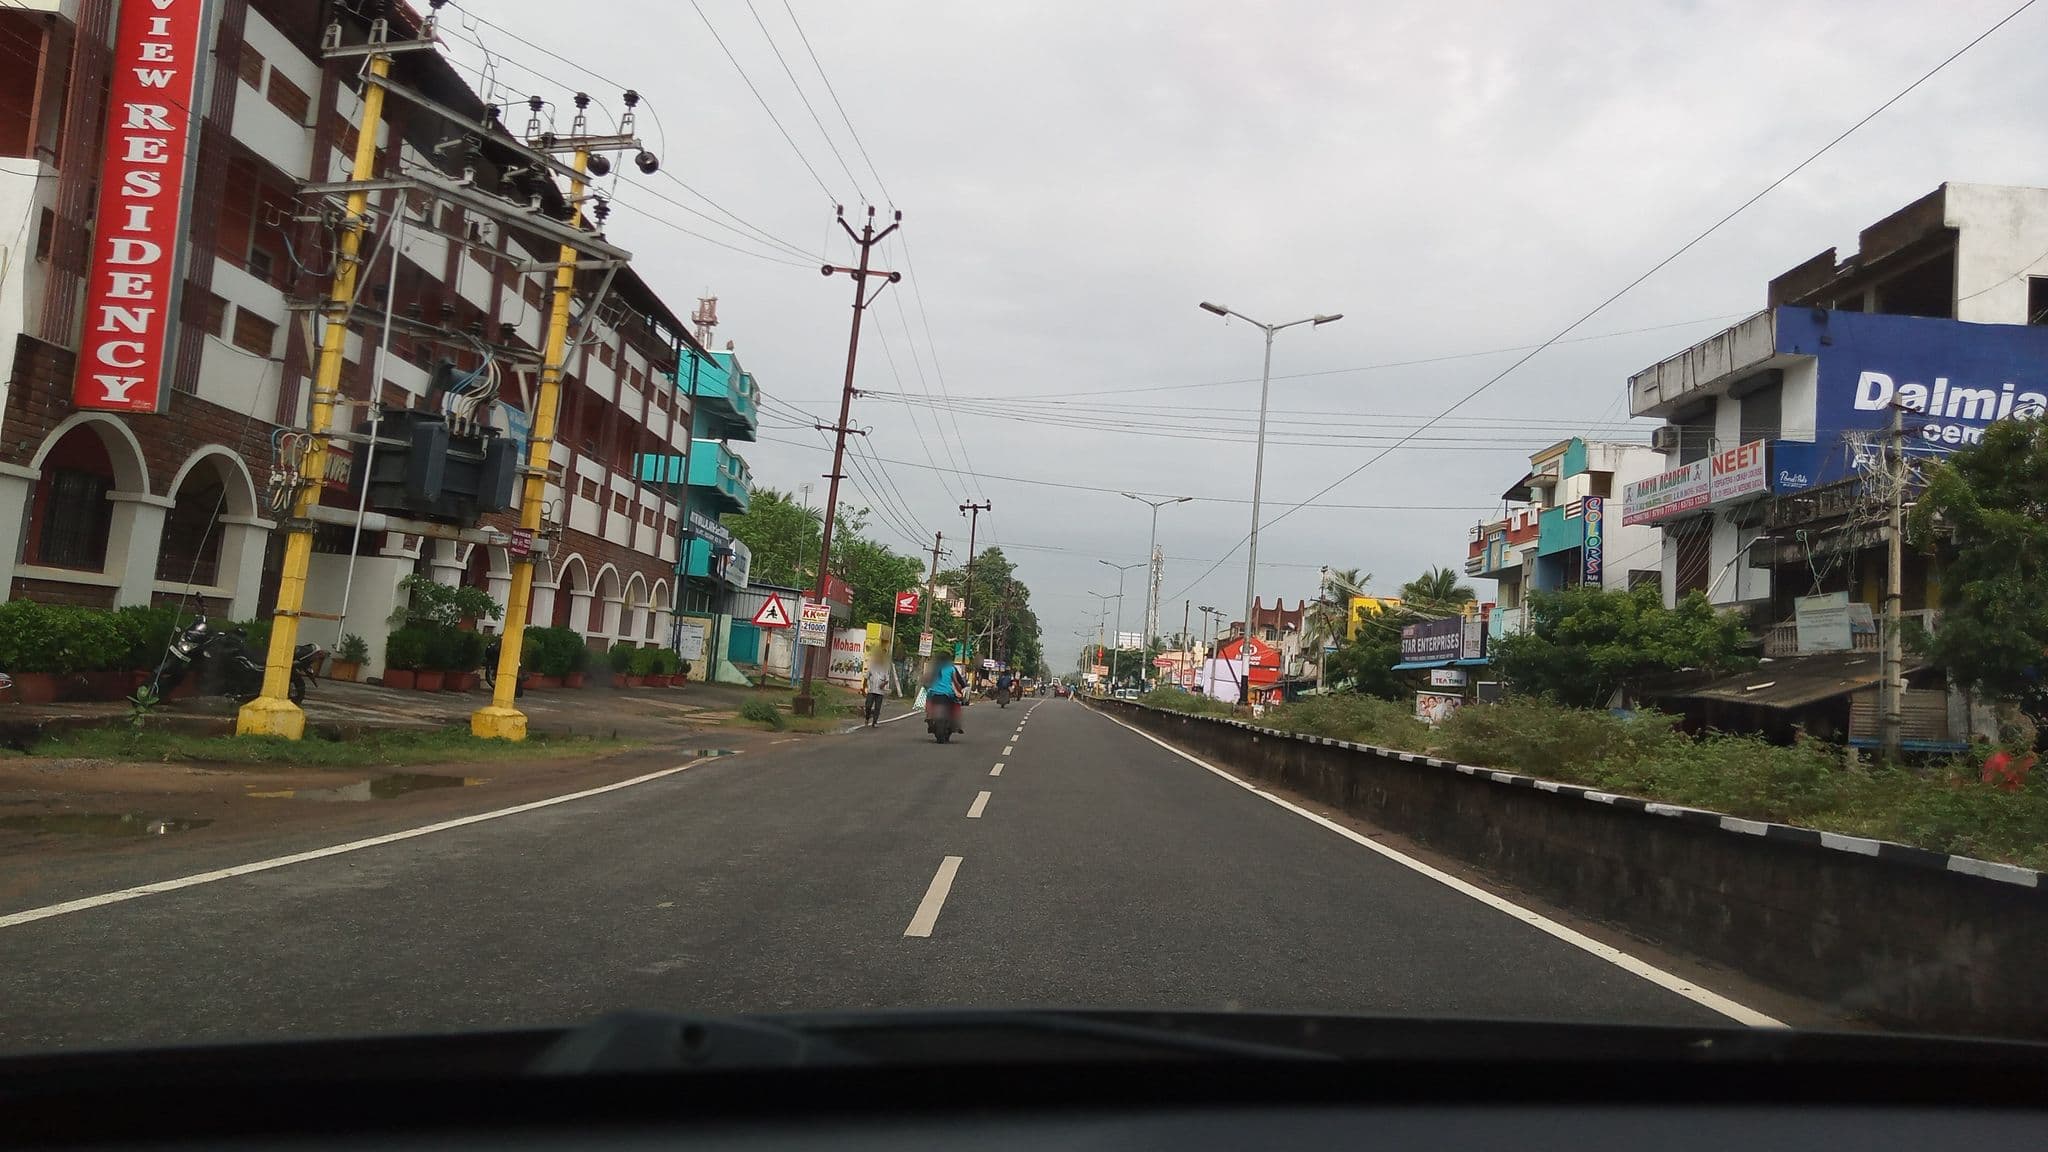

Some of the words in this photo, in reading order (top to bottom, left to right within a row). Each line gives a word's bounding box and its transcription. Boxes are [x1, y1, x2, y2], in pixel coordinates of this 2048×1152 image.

[93, 103, 175, 402] RESIDENCY
[1854, 371, 2048, 422] Dalmia
[1712, 442, 1761, 477] NEET
[1637, 480, 1657, 498] AARYA
[1659, 465, 1691, 492] ACADEMY
[1585, 498, 1601, 574] COLORS
[1401, 638, 1416, 653] STAR
[1417, 633, 1459, 652] ENTERPRISES
